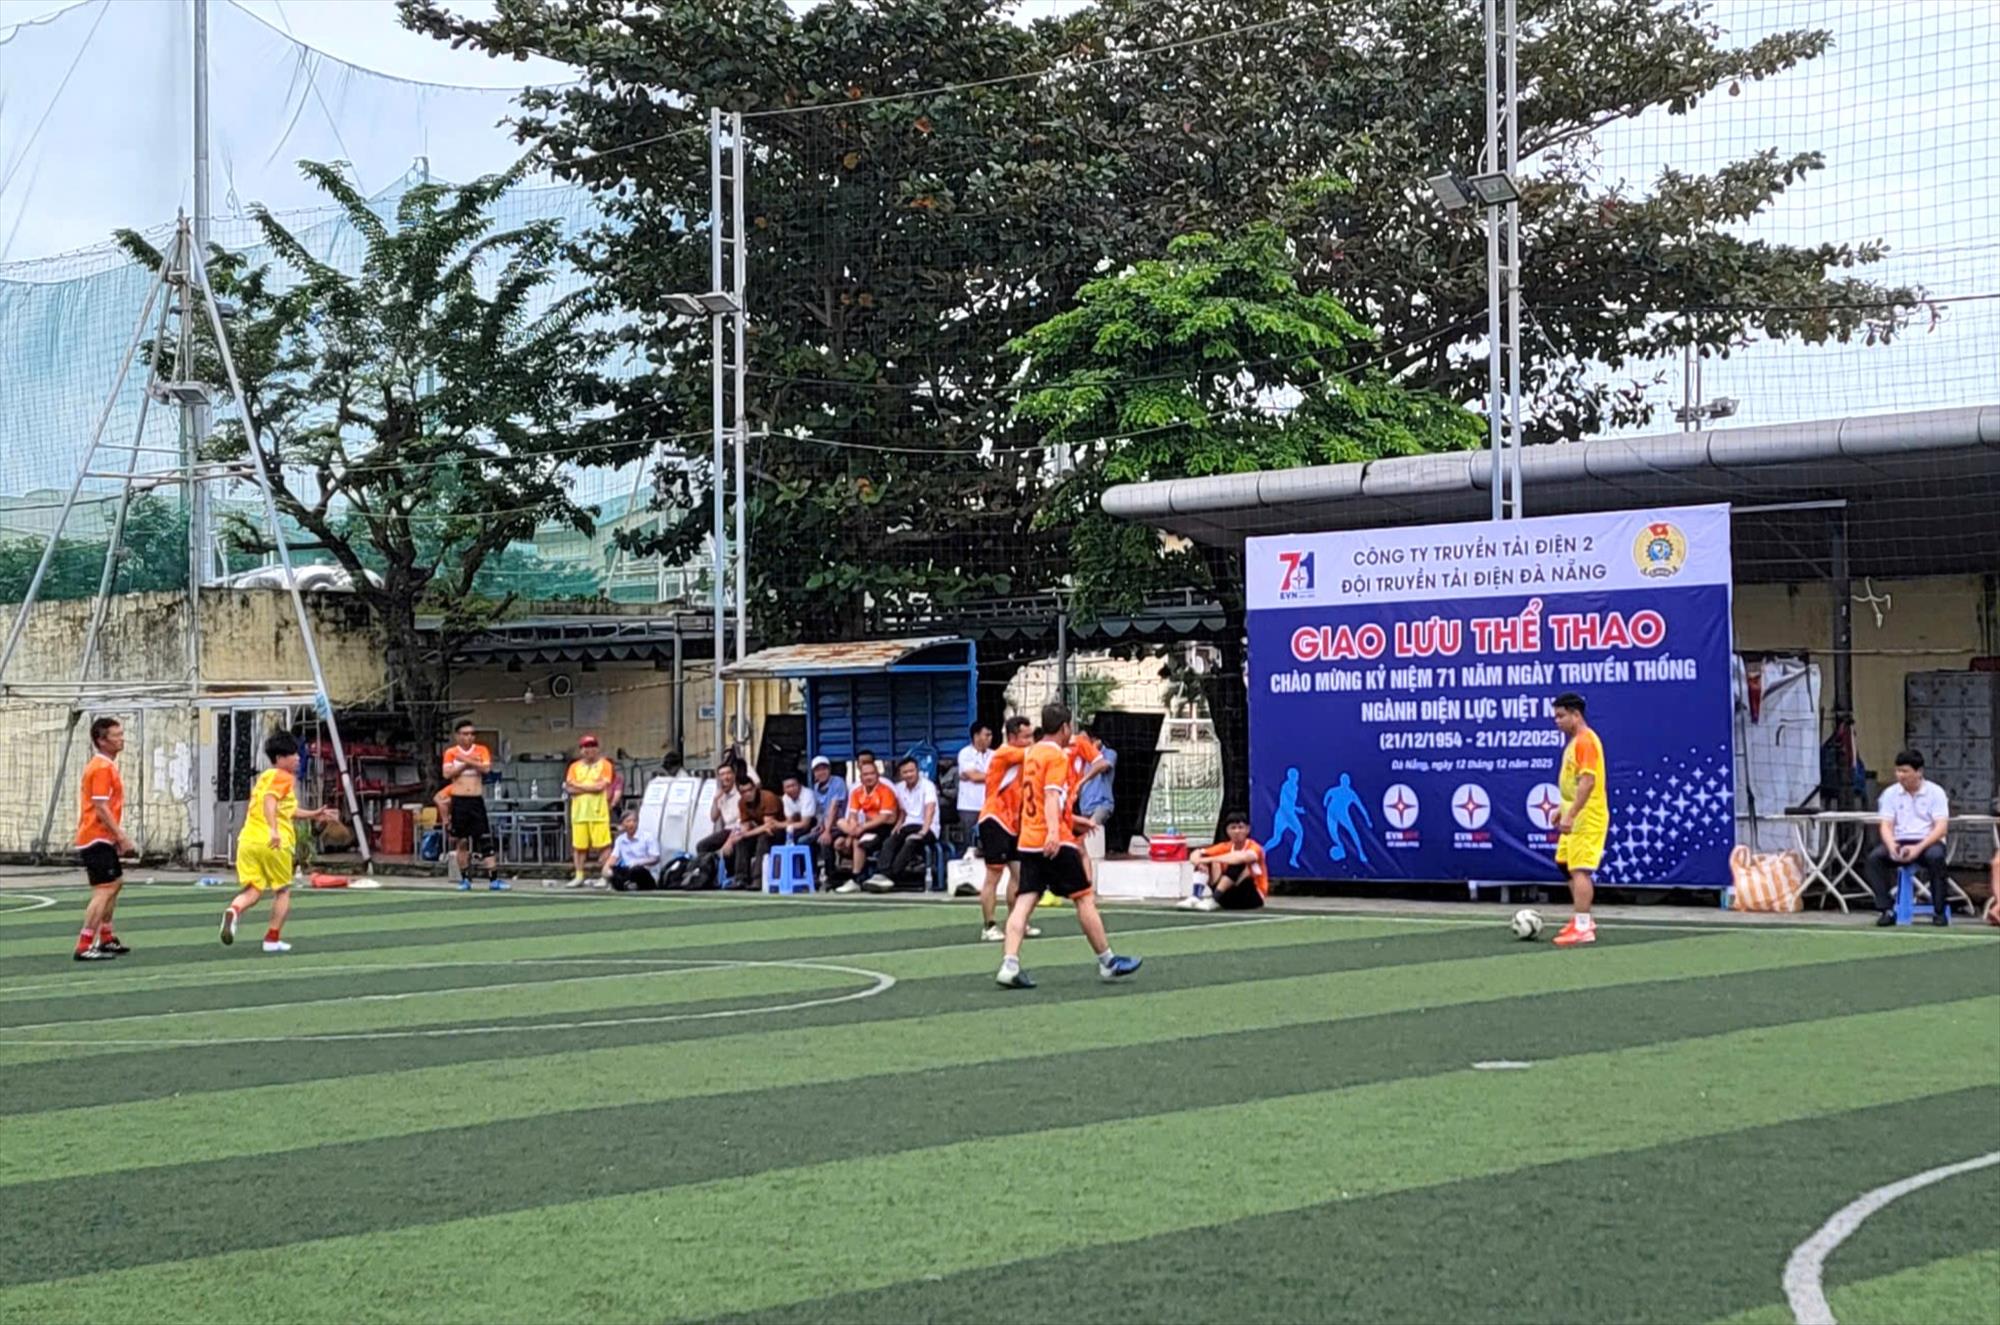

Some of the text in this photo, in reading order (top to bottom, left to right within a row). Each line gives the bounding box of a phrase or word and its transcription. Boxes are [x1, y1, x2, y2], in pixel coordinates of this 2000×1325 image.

[1354, 547, 1405, 566] CÔNG
[1410, 548, 1429, 564] TY
[1502, 535, 1529, 557] TẢI
[1535, 534, 1577, 559] ĐIỆN
[1583, 536, 1593, 552] 2
[1342, 572, 1370, 597] ĐỘI
[1442, 567, 1467, 588] TẢI
[1474, 565, 1514, 590] ĐIỆN
[1520, 562, 1546, 584] ĐÀ
[1552, 559, 1607, 583] NẴNG
[1292, 598, 1666, 662] GIAO LƯU THỂ THAO
[1270, 669, 1311, 693] CHÀO
[1315, 667, 1362, 692] MỪNG
[1366, 664, 1387, 690] KỶ
[1390, 665, 1433, 692] NIỆM
[1436, 667, 1455, 688] 71
[1462, 662, 1503, 687] NĂM
[1507, 660, 1554, 686] NGÀY
[1633, 652, 1697, 682] THỐNG
[1361, 698, 1417, 722] NGÀNH
[1421, 696, 1460, 724] ĐIỆN
[1464, 697, 1497, 724] LỰC
[1501, 694, 1539, 723] VIỆT
[1380, 731, 1462, 750] (21/12/1954
[1476, 730, 1565, 748] 21/12/2025)
[1456, 759, 1467, 769] 12
[1496, 758, 1507, 769] 12
[1530, 757, 1553, 769] 2025
